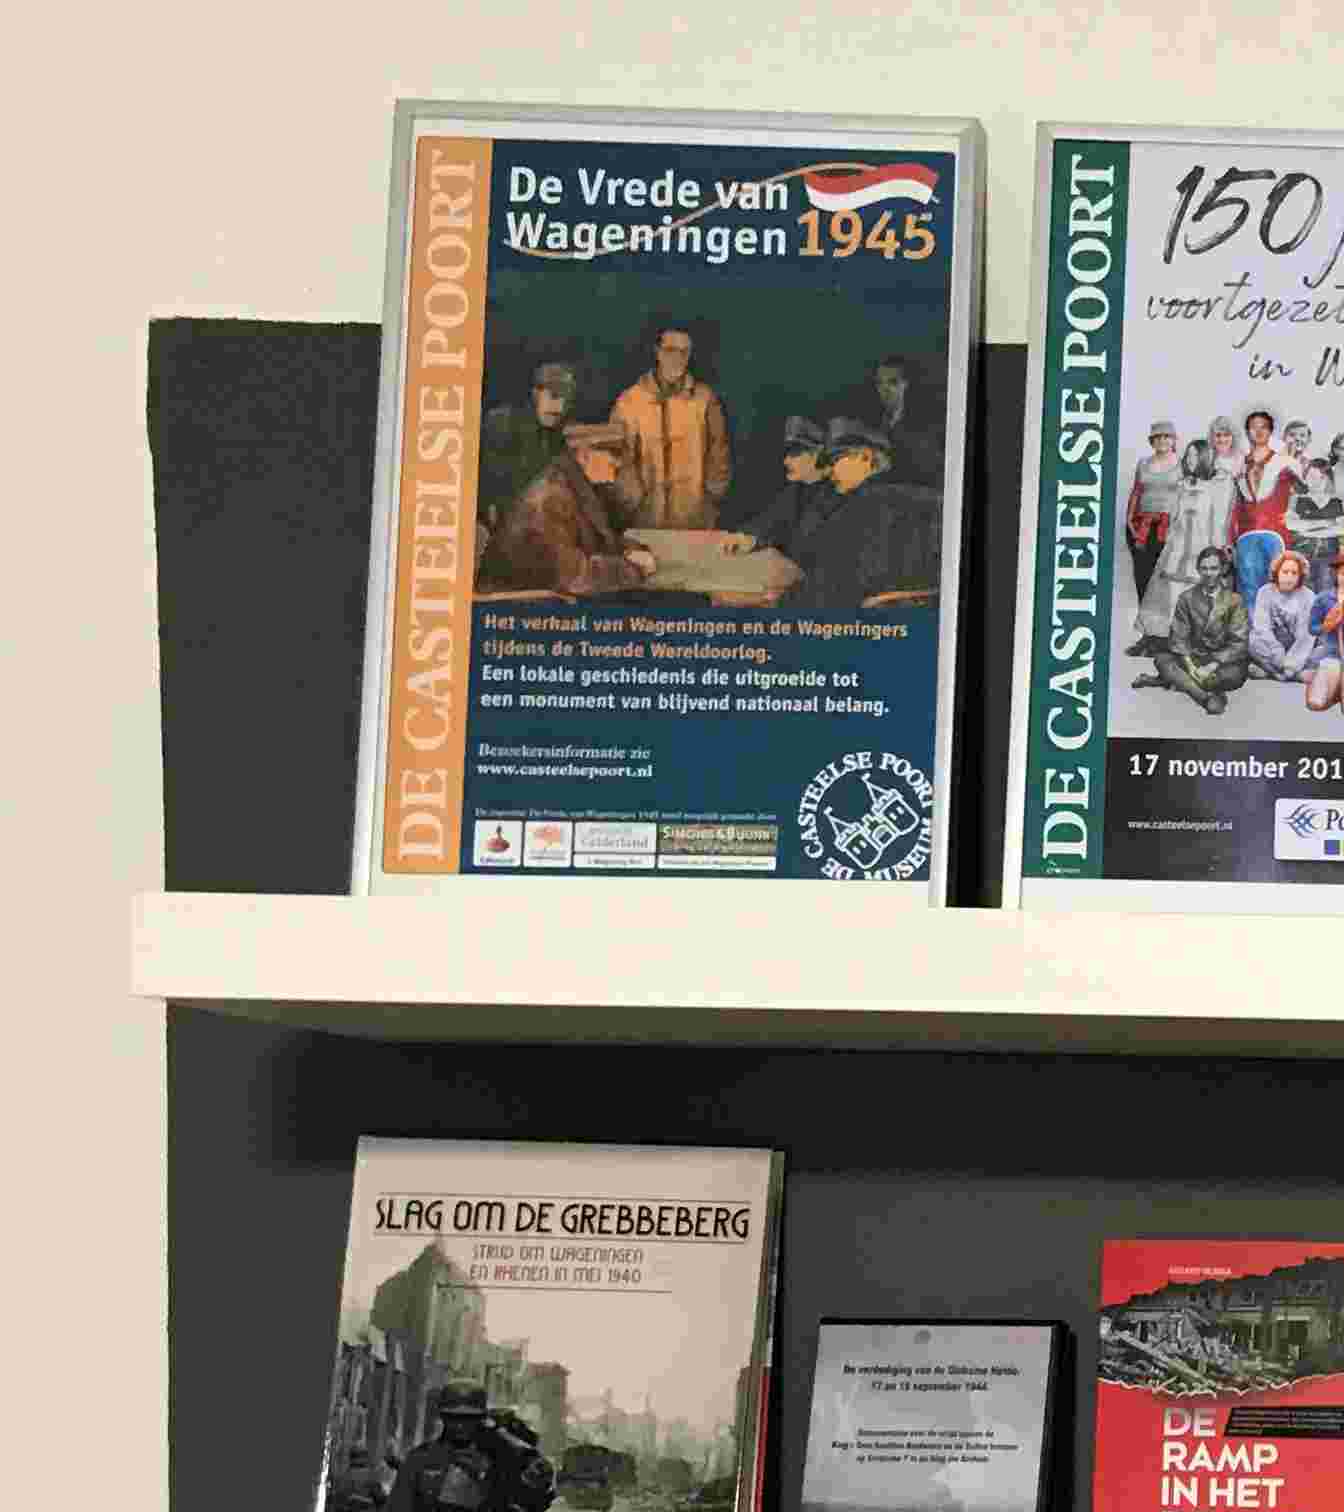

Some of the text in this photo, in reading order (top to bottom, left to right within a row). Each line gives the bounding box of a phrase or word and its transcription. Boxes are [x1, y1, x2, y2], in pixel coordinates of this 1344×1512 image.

[509, 166, 787, 210] De Vrede van
[1162, 165, 1324, 264] 150
[505, 209, 936, 263] Wageningen 1945
[1248, 345, 1293, 382] in
[400, 150, 477, 860] DE CASTEELSE POORT
[1042, 155, 1115, 860] DE CASTEELSE POORT
[482, 664, 858, 691] Een lokale geschiedenis die uitgroeide tot
[480, 693, 889, 716] een monument van blijvend nationaal belang.
[1128, 755, 1159, 776] 17
[1168, 755, 1289, 779] november
[375, 1198, 749, 1239] SLAG OM DE GREBBEBERG
[1163, 1408, 1216, 1437] DE
[1161, 1442, 1279, 1473] RAMP
[1161, 1477, 1284, 1507] IN HET
